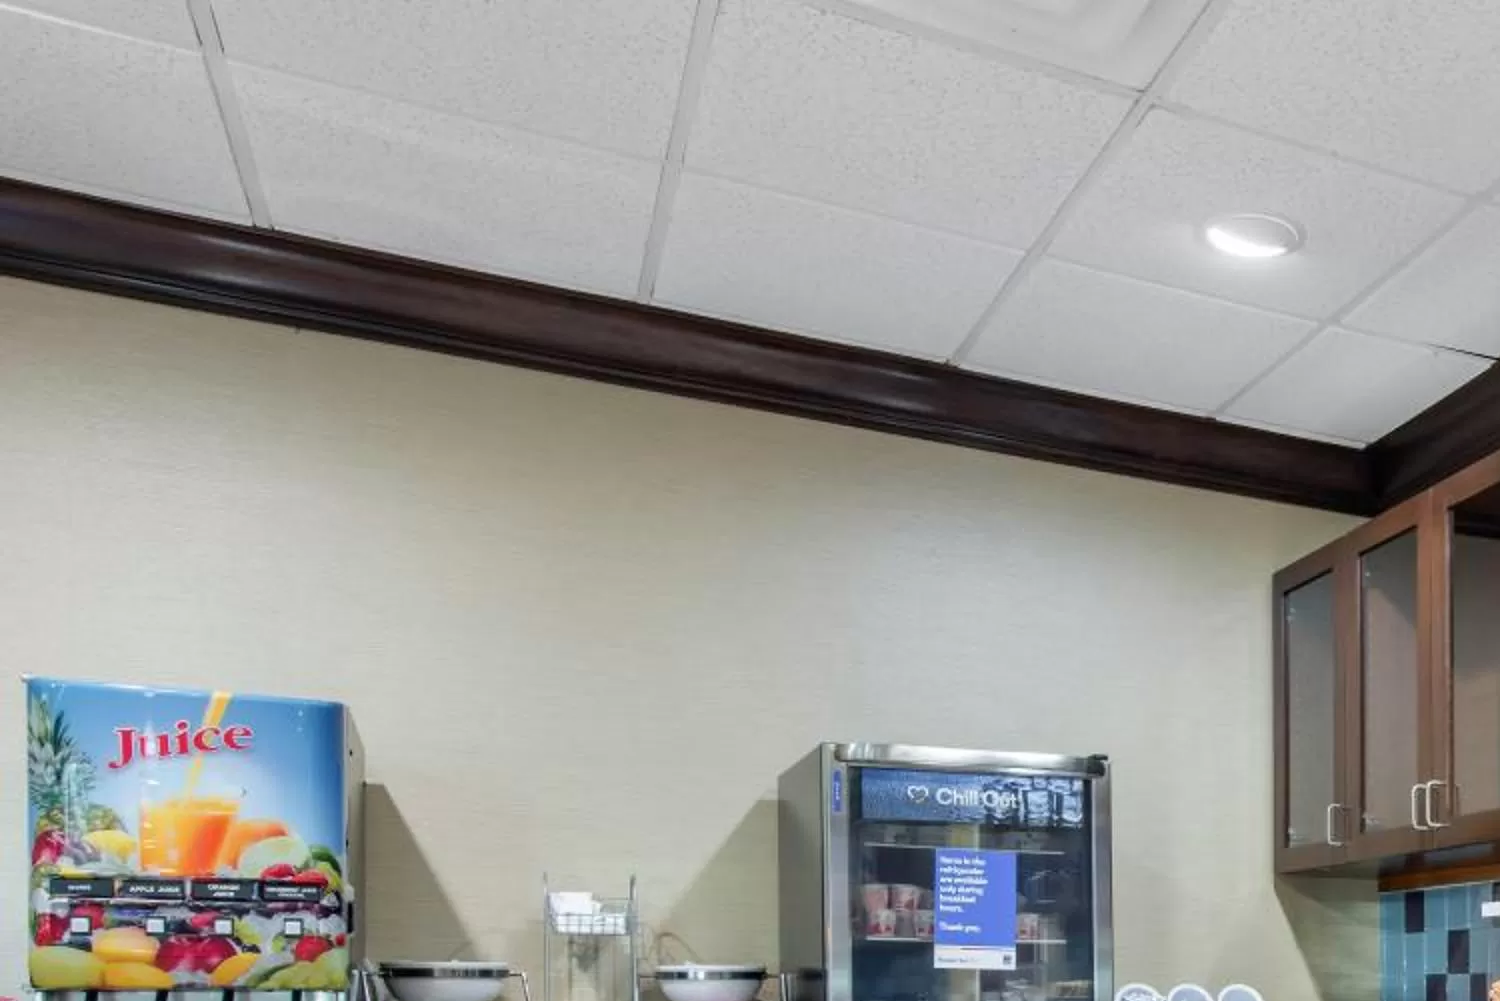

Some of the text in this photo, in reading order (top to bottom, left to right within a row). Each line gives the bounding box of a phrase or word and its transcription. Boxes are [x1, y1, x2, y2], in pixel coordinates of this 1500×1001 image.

[107, 719, 254, 769] Juice
[936, 786, 978, 807] Chill
[129, 885, 155, 893] APPLE
